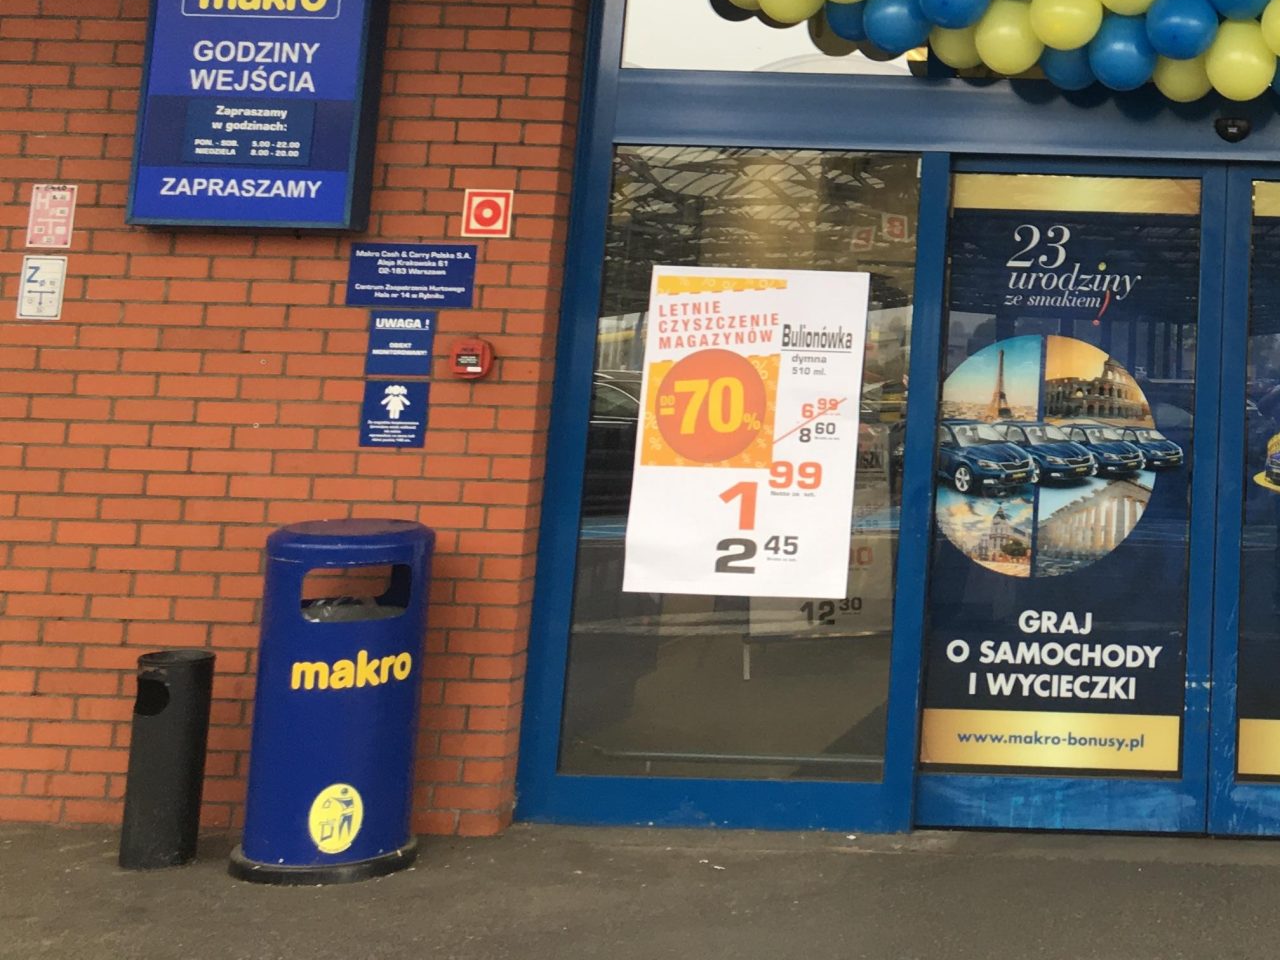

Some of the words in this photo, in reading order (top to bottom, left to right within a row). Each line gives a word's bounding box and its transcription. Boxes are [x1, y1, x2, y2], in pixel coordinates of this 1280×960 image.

[193, 40, 320, 64] GODZINY
[190, 66, 315, 92] WEJŚCIA
[215, 105, 288, 120] Zapraszamy
[211, 121, 223, 130] w
[225, 120, 287, 132] godzinach:
[160, 177, 322, 198] ZAPRASZAMY
[356, 250, 380, 258] Makro
[381, 250, 400, 258] Cash
[409, 251, 430, 259] Carry
[1006, 223, 1071, 269] 23
[26, 266, 40, 283] Z
[1007, 261, 1142, 300] urodziny
[659, 301, 721, 317] LETNIE
[1004, 293, 1022, 306] ze
[375, 318, 421, 329] UWAGA
[658, 313, 780, 333] CZYSZCZENIE
[659, 328, 773, 350] MAGAZYNÓW
[781, 323, 853, 350] Bulionówka
[791, 353, 827, 366] dymna
[792, 367, 812, 376] 510
[813, 366, 827, 375] ml.
[659, 395, 676, 406] DO
[802, 403, 814, 419] 6
[799, 427, 811, 443] 8
[815, 422, 836, 435] 60
[719, 481, 758, 530] 1
[768, 460, 822, 490] 99
[714, 538, 757, 574] 2
[764, 536, 799, 555] 45
[801, 600, 835, 625] 12
[1018, 609, 1092, 635] GRAJ
[946, 639, 970, 663] O
[979, 640, 1163, 668] SAMOCHODY
[291, 650, 412, 690] makro
[968, 672, 977, 695] I
[986, 672, 1137, 700] WYCIECZKI
[957, 731, 1145, 752] www.makro-bonusy.pl
